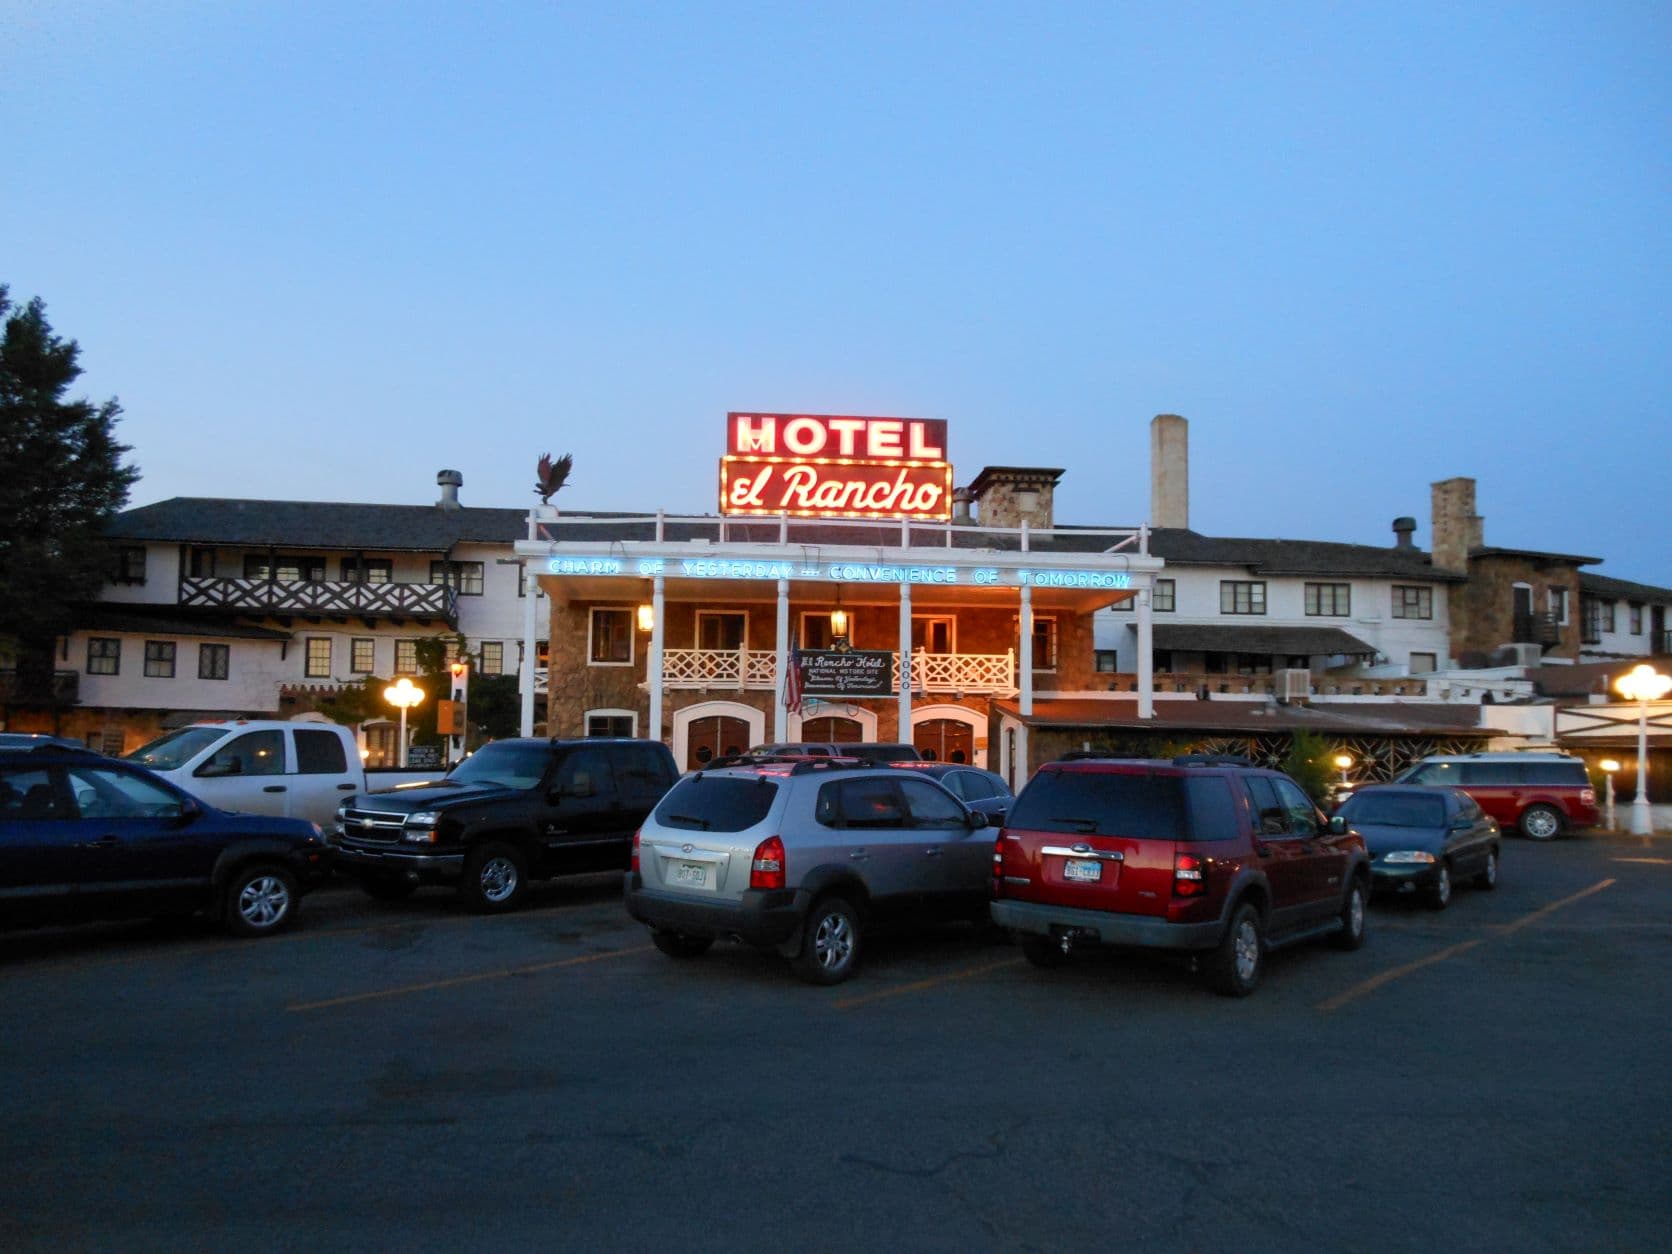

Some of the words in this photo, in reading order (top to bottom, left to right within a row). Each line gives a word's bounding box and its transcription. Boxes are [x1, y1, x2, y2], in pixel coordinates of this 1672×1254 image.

[780, 465, 943, 510] Rancho
[551, 559, 620, 574] CHARM
[639, 561, 663, 575] OF
[682, 561, 793, 578] YESTERDAY
[830, 566, 957, 583] CONVENIENCE
[974, 570, 999, 584] OF
[1020, 571, 1131, 588] TOMORROW
[856, 656, 886, 668] Hotel
